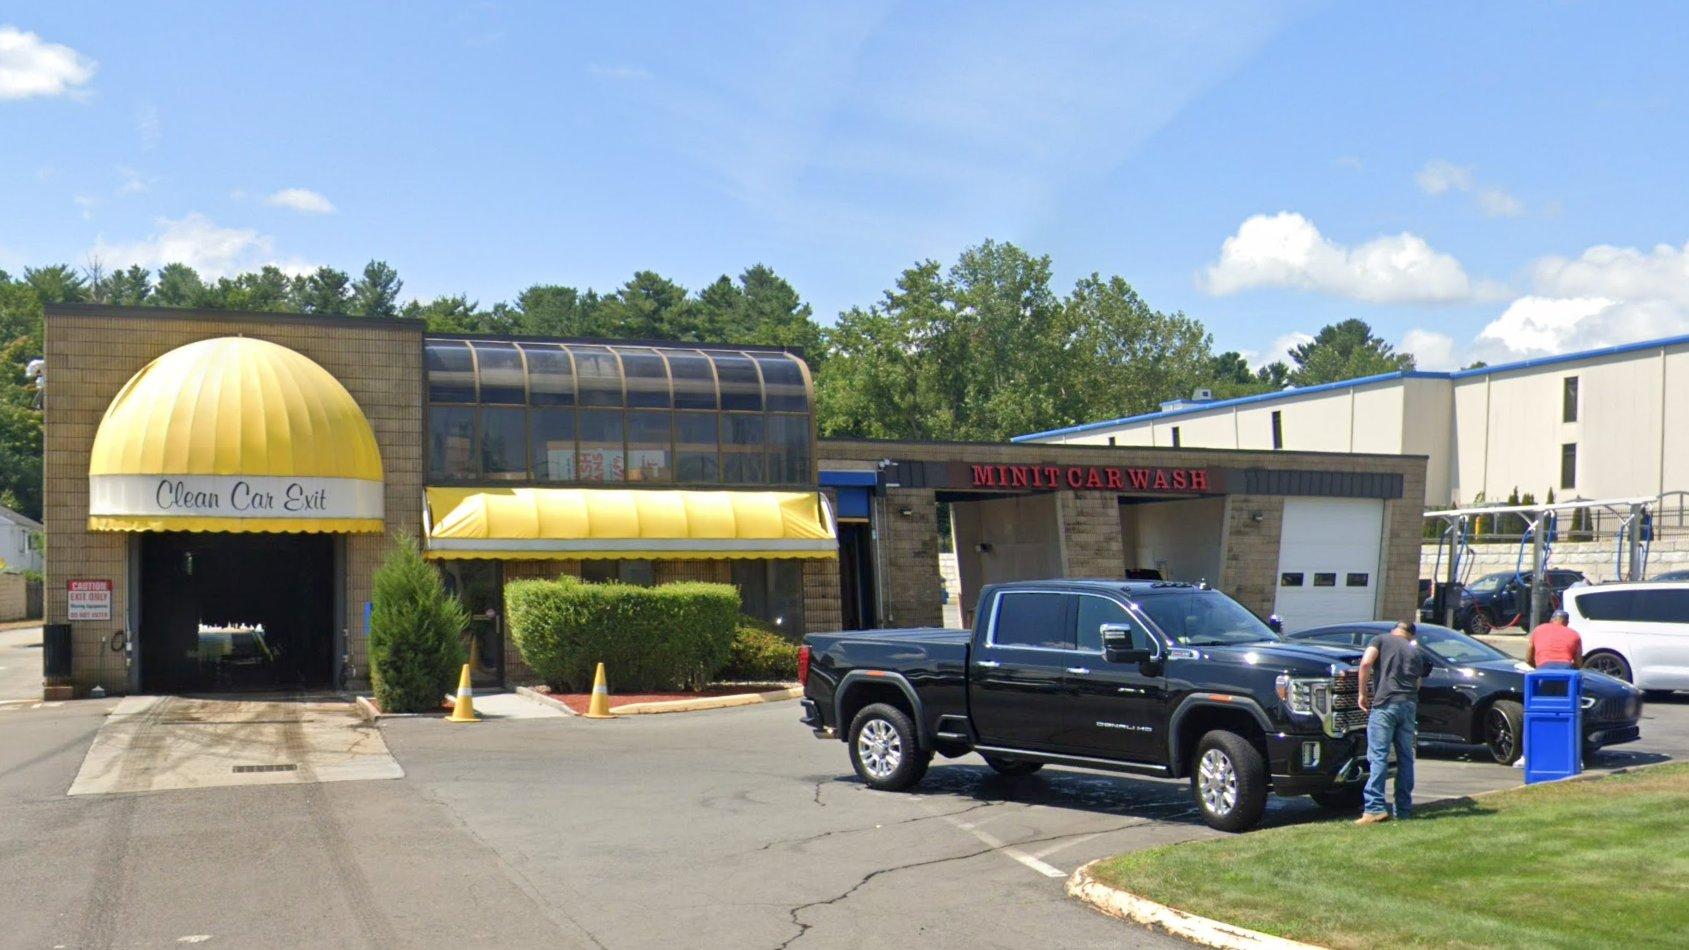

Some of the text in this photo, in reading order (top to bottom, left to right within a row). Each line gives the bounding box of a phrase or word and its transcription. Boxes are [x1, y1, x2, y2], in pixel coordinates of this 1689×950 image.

[972, 464, 1209, 490] MINIT CAR WASH
[156, 479, 327, 511] Clean Car Exit
[71, 581, 107, 590] CAUTION
[70, 593, 108, 601] EXIT ONLY
[1096, 721, 1135, 730] DENALI
